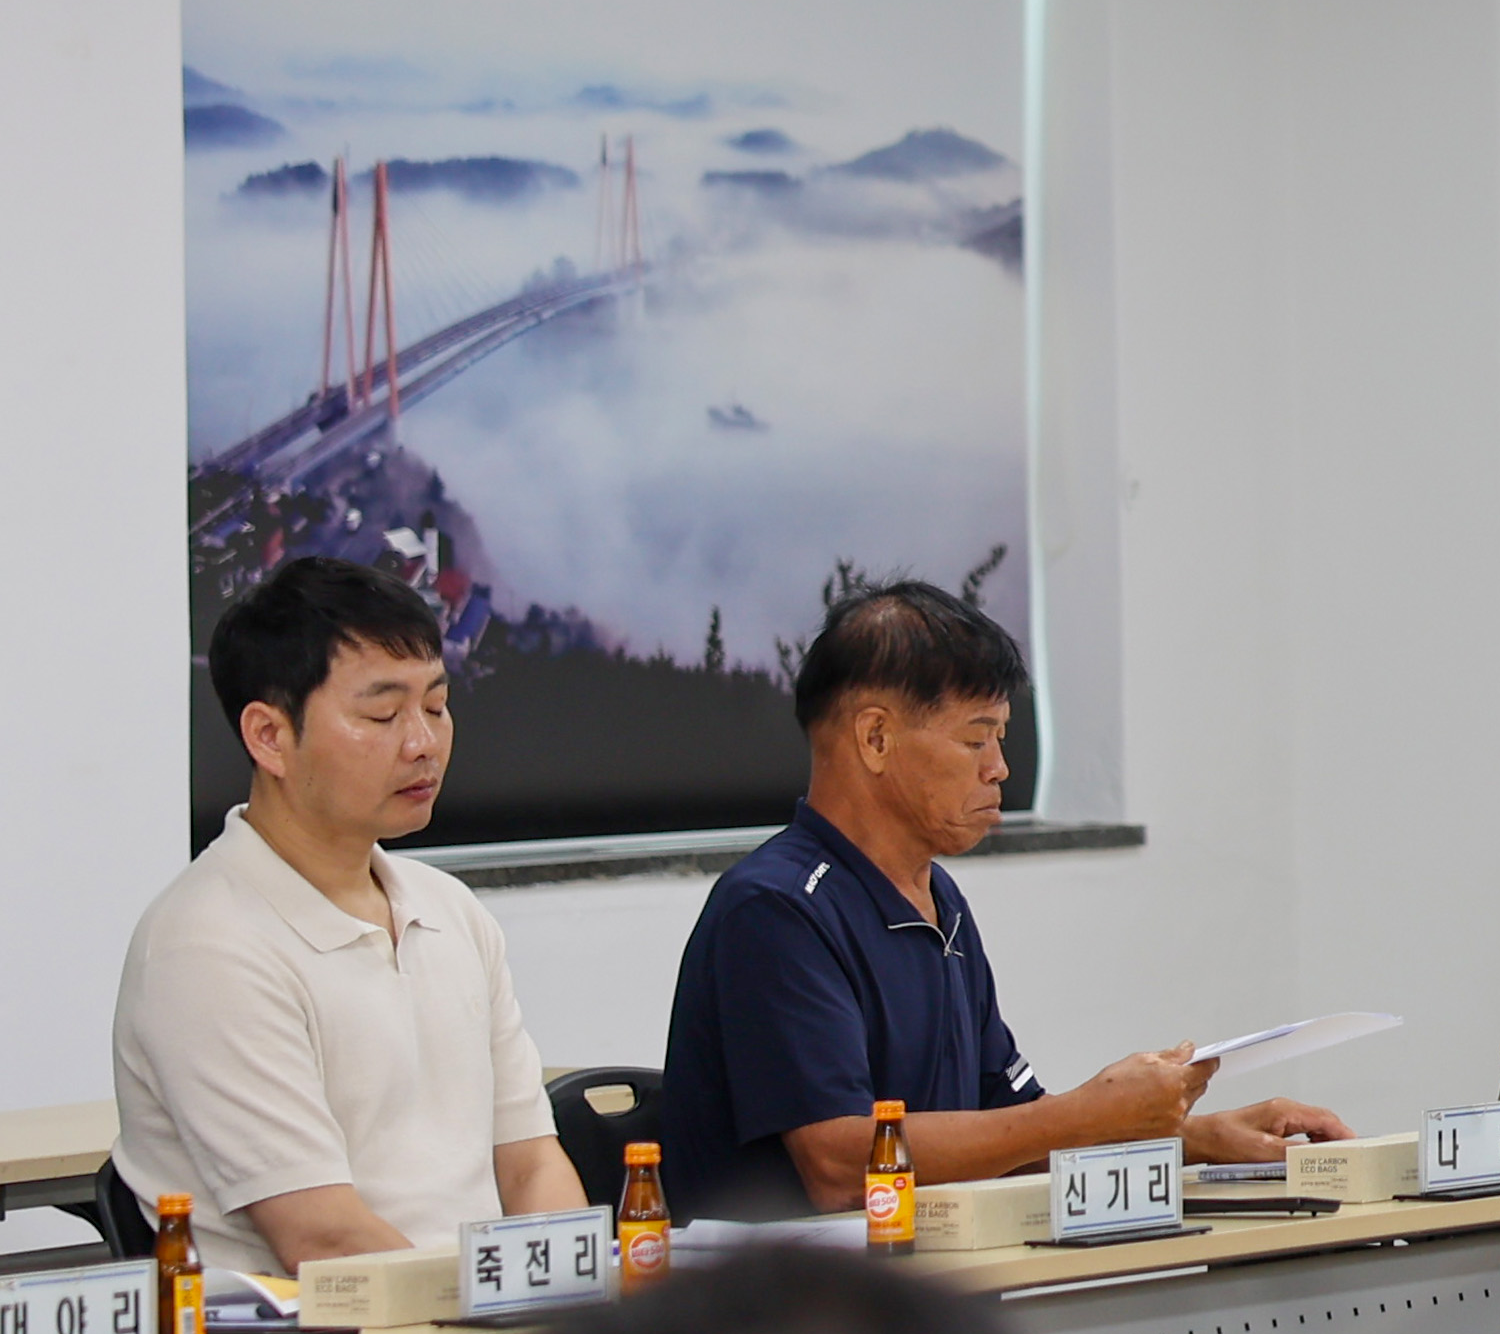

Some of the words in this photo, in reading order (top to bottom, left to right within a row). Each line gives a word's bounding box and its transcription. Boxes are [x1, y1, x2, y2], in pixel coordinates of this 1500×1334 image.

[1318, 1157, 1348, 1165] CARBON
[1318, 1165, 1338, 1173] BAGS
[1065, 1162, 1169, 1217] 신기리
[476, 1233, 598, 1292] 죽전리
